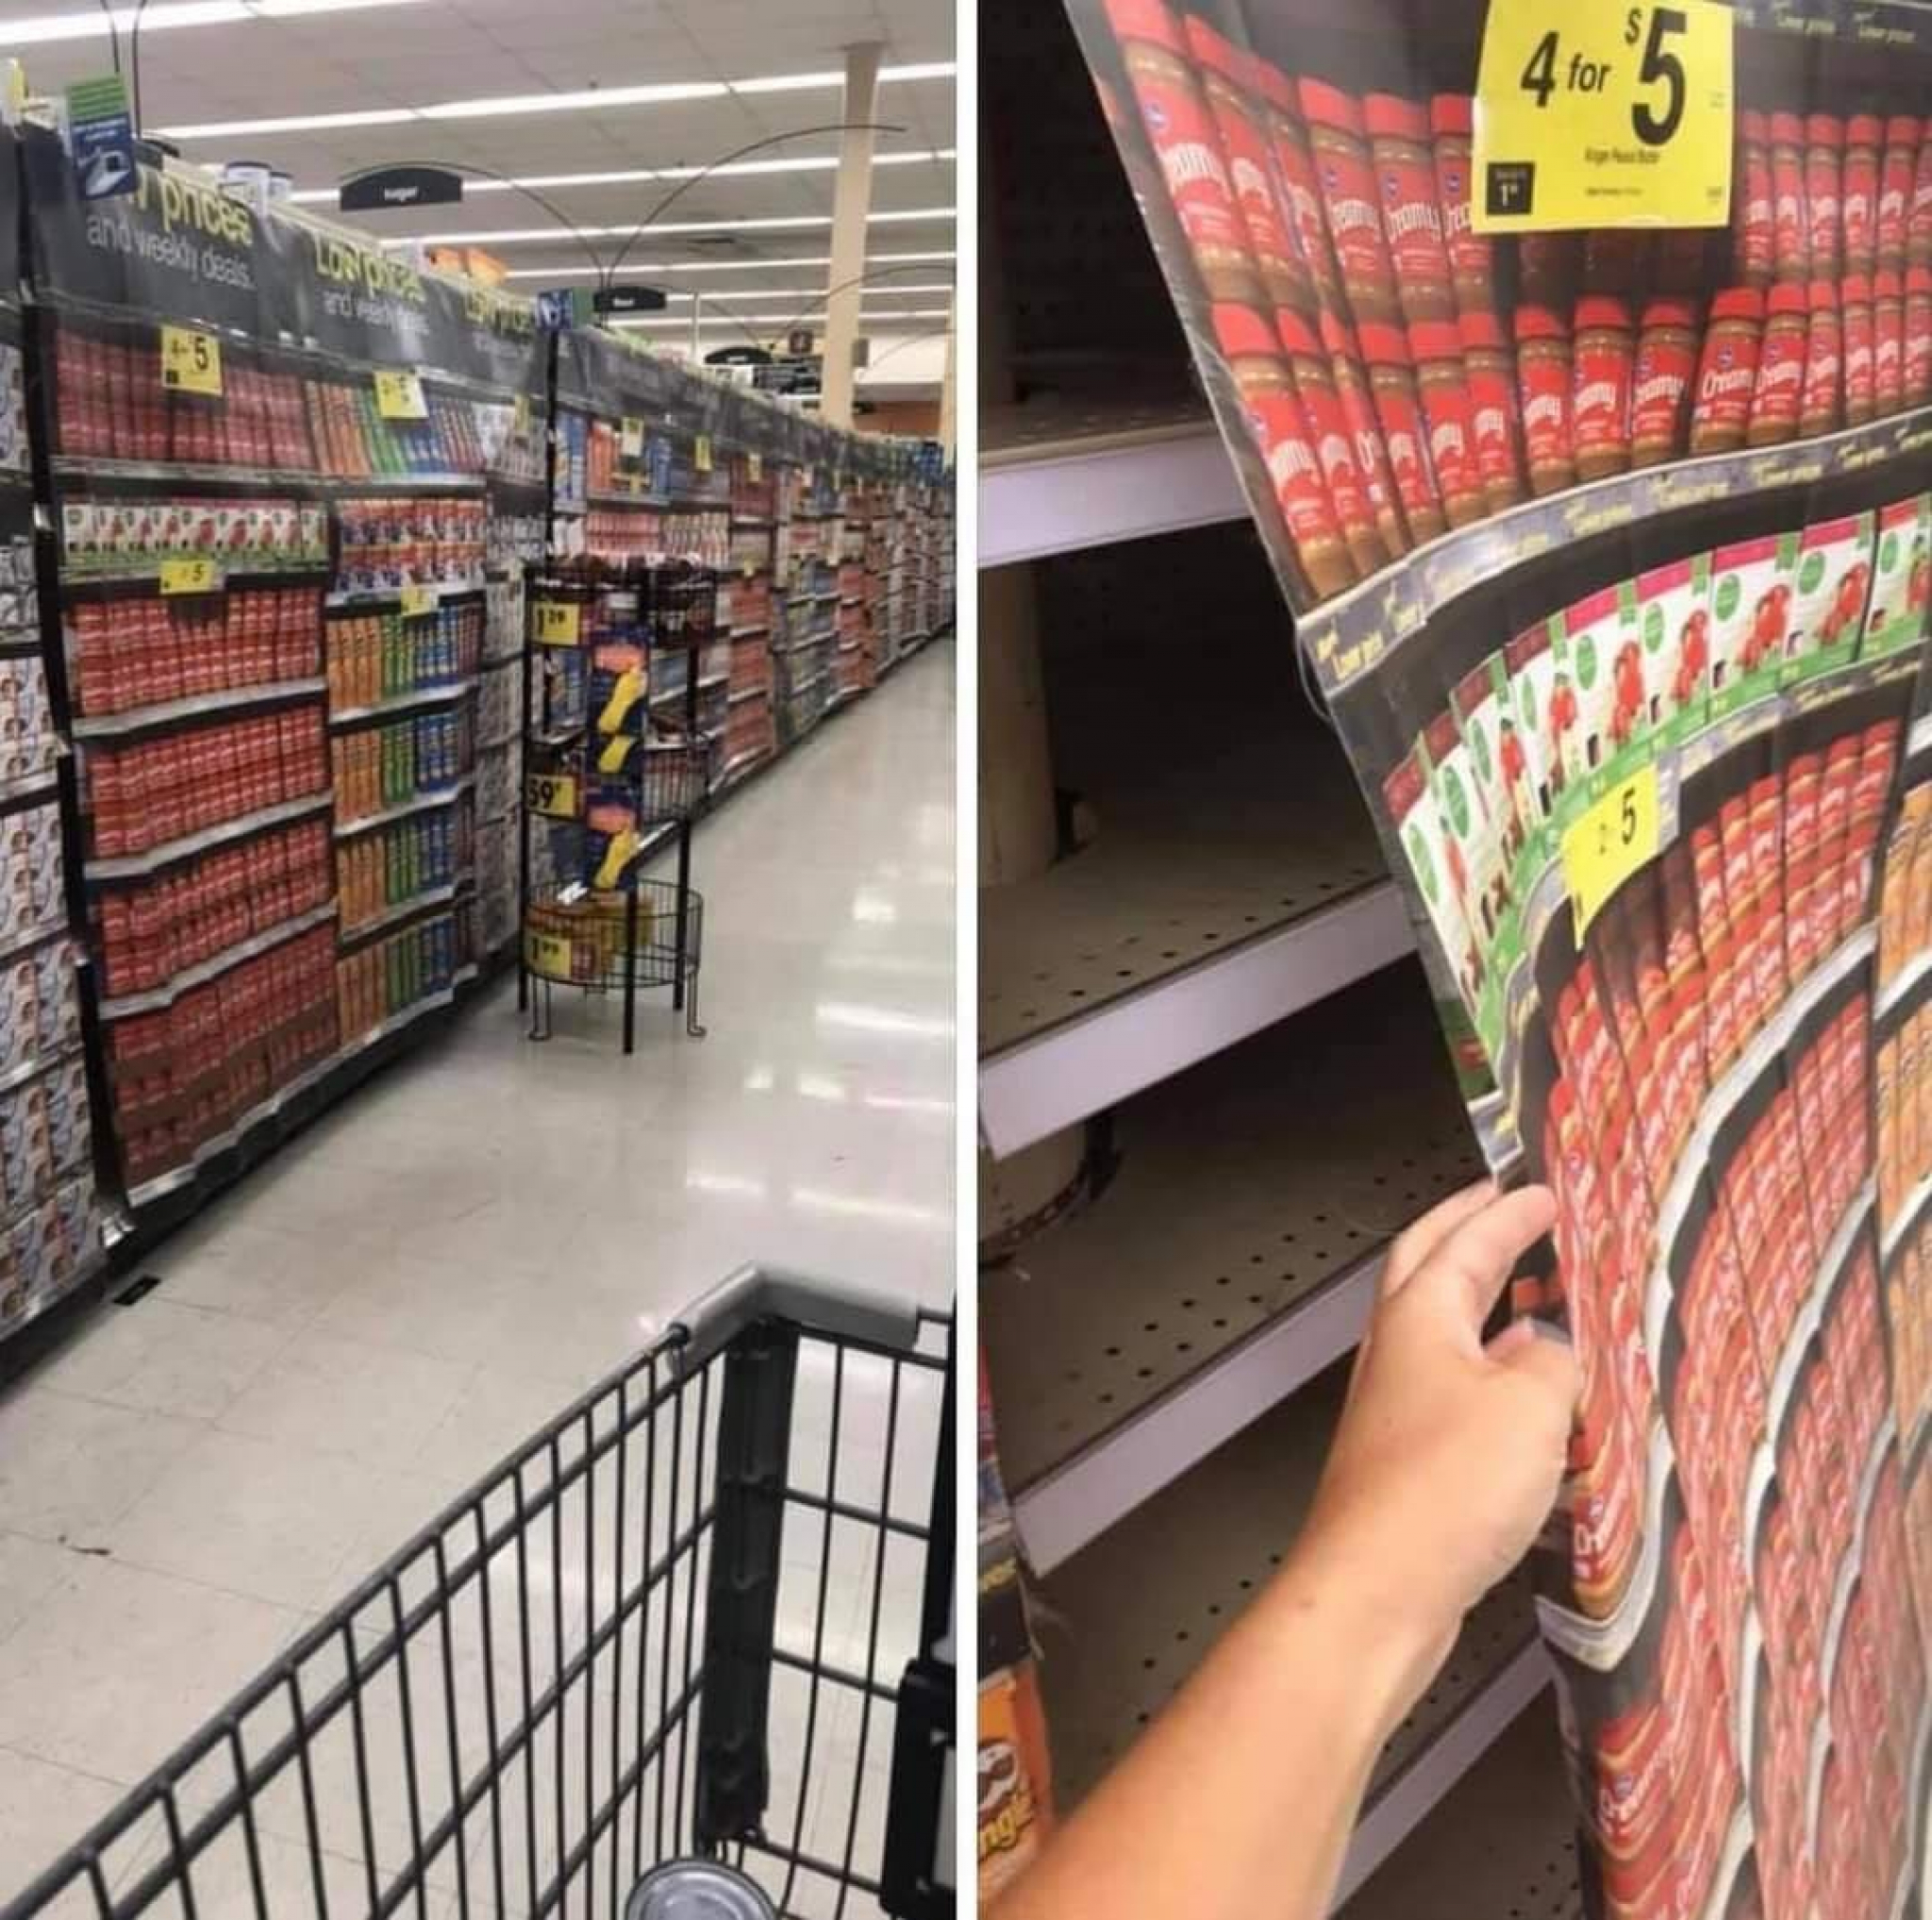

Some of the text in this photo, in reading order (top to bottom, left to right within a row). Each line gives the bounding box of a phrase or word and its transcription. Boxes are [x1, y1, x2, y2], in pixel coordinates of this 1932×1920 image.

[1520, 30, 1559, 108] 4
[1567, 53, 1611, 92] for
[87, 213, 132, 254] and
[158, 172, 254, 247] prices
[194, 336, 209, 370] 5
[1621, 786, 1637, 845] 5
